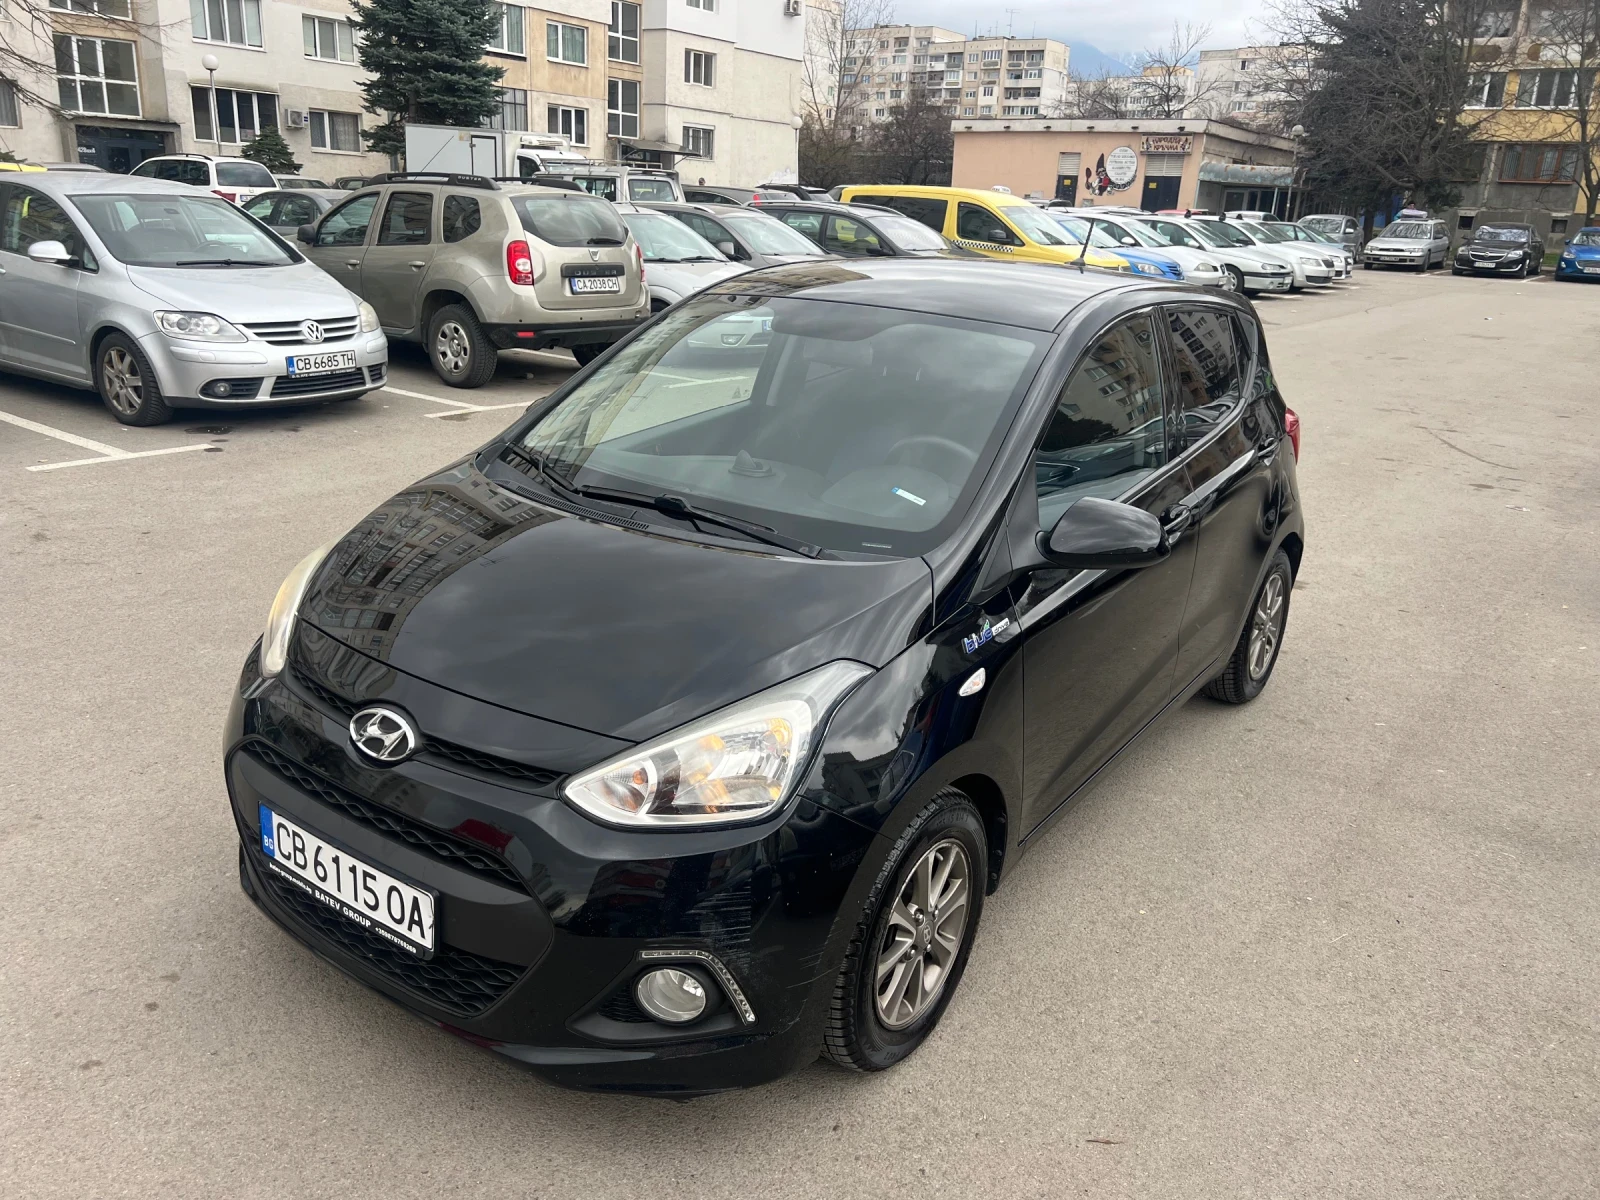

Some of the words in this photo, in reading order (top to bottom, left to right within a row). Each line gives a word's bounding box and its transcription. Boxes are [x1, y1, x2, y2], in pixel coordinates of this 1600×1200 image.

[577, 279, 588, 290] CA
[588, 278, 607, 290] 2038
[607, 278, 618, 289] CH
[296, 358, 311, 371] CB
[314, 354, 339, 369] 6685
[340, 353, 354, 366] TH
[963, 628, 993, 654] blue
[263, 834, 274, 850] BG
[276, 821, 308, 870] CB
[313, 845, 380, 912] 6115
[386, 884, 426, 939] OA
[315, 889, 341, 911] BATEV
[342, 906, 372, 928] GROUP
